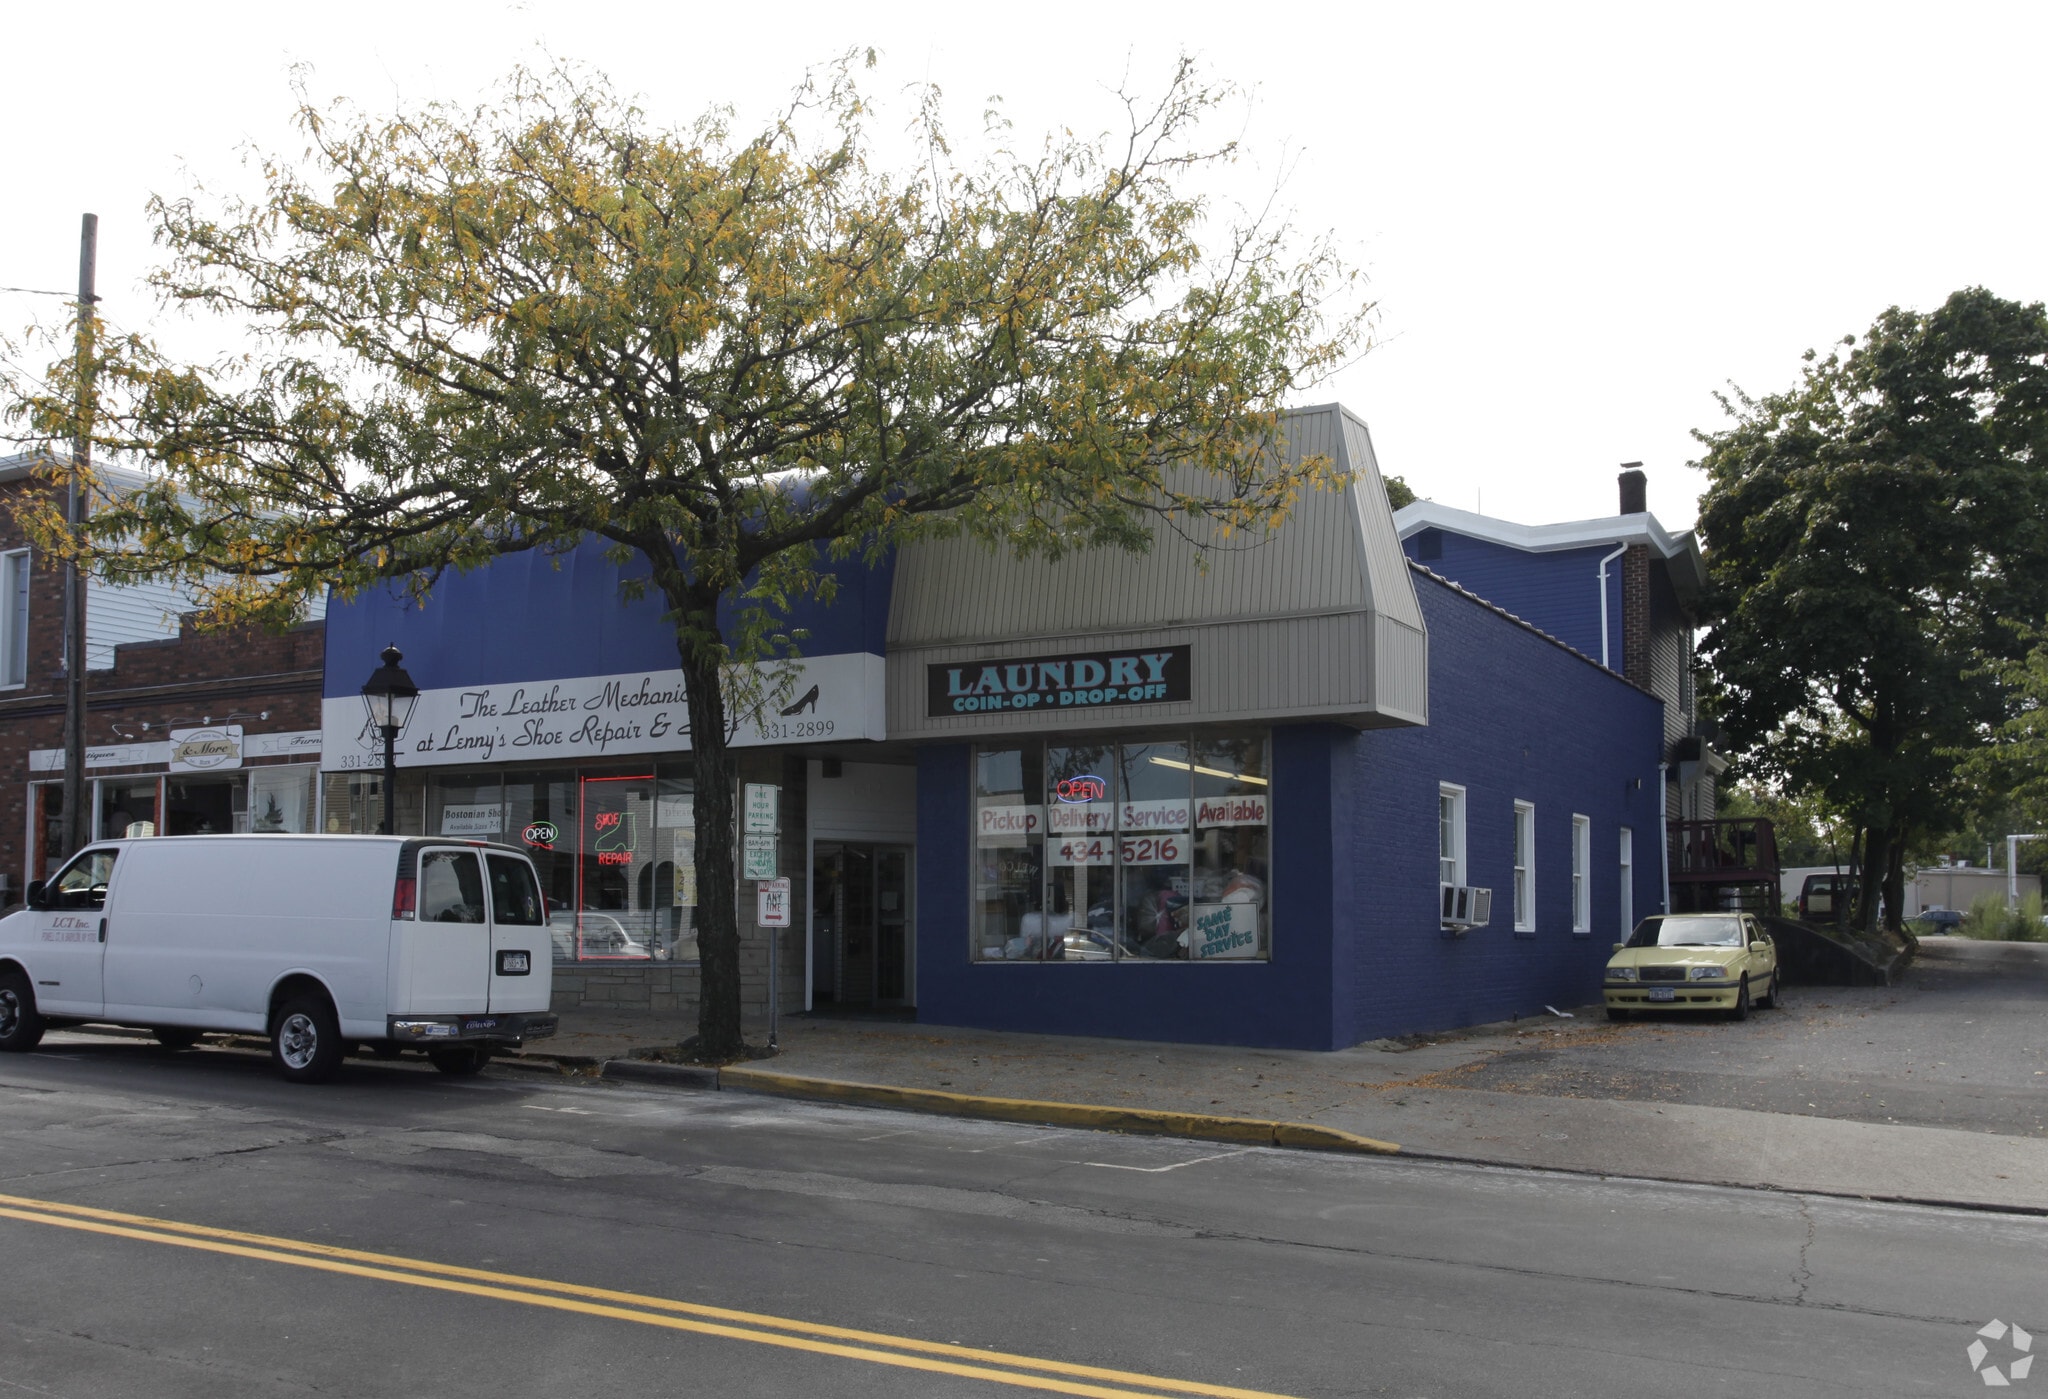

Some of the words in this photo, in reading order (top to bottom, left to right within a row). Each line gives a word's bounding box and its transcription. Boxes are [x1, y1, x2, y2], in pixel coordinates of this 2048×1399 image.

[946, 652, 1174, 696] LAUNDRY
[460, 689, 498, 719] The
[501, 684, 577, 716] Leather
[952, 692, 1042, 712] COIN-OP
[1059, 683, 1169, 706] DROP-OFF
[416, 732, 434, 752] at
[436, 724, 507, 760] Lenny's
[512, 717, 564, 746] Shoe
[569, 714, 641, 753] Repair
[649, 712, 672, 738] &
[761, 720, 835, 740] 331-2899
[182, 745, 193, 755] &
[194, 741, 228, 754] More
[754, 791, 767, 799] ONE
[1057, 779, 1105, 799] OPEN
[445, 809, 486, 819] Bostonian
[752, 801, 769, 809] HOUR
[594, 811, 620, 831] SHOE
[748, 812, 773, 820] PARKING
[981, 810, 1037, 833] Pickup
[1050, 807, 1112, 831] Delivery
[1123, 805, 1188, 827] Service
[1197, 799, 1266, 824] Available
[525, 827, 554, 840] OPEN
[598, 851, 633, 865] REPAIR
[1060, 837, 1178, 863] 434-5216
[760, 881, 769, 890] NO
[765, 902, 782, 912] TIME
[766, 893, 783, 903] ANY
[52, 917, 75, 928] LCT
[75, 919, 90, 929] Inc.
[1197, 907, 1233, 931] SAME
[1205, 922, 1230, 942] DAY
[1200, 930, 1253, 959] SERVICE
